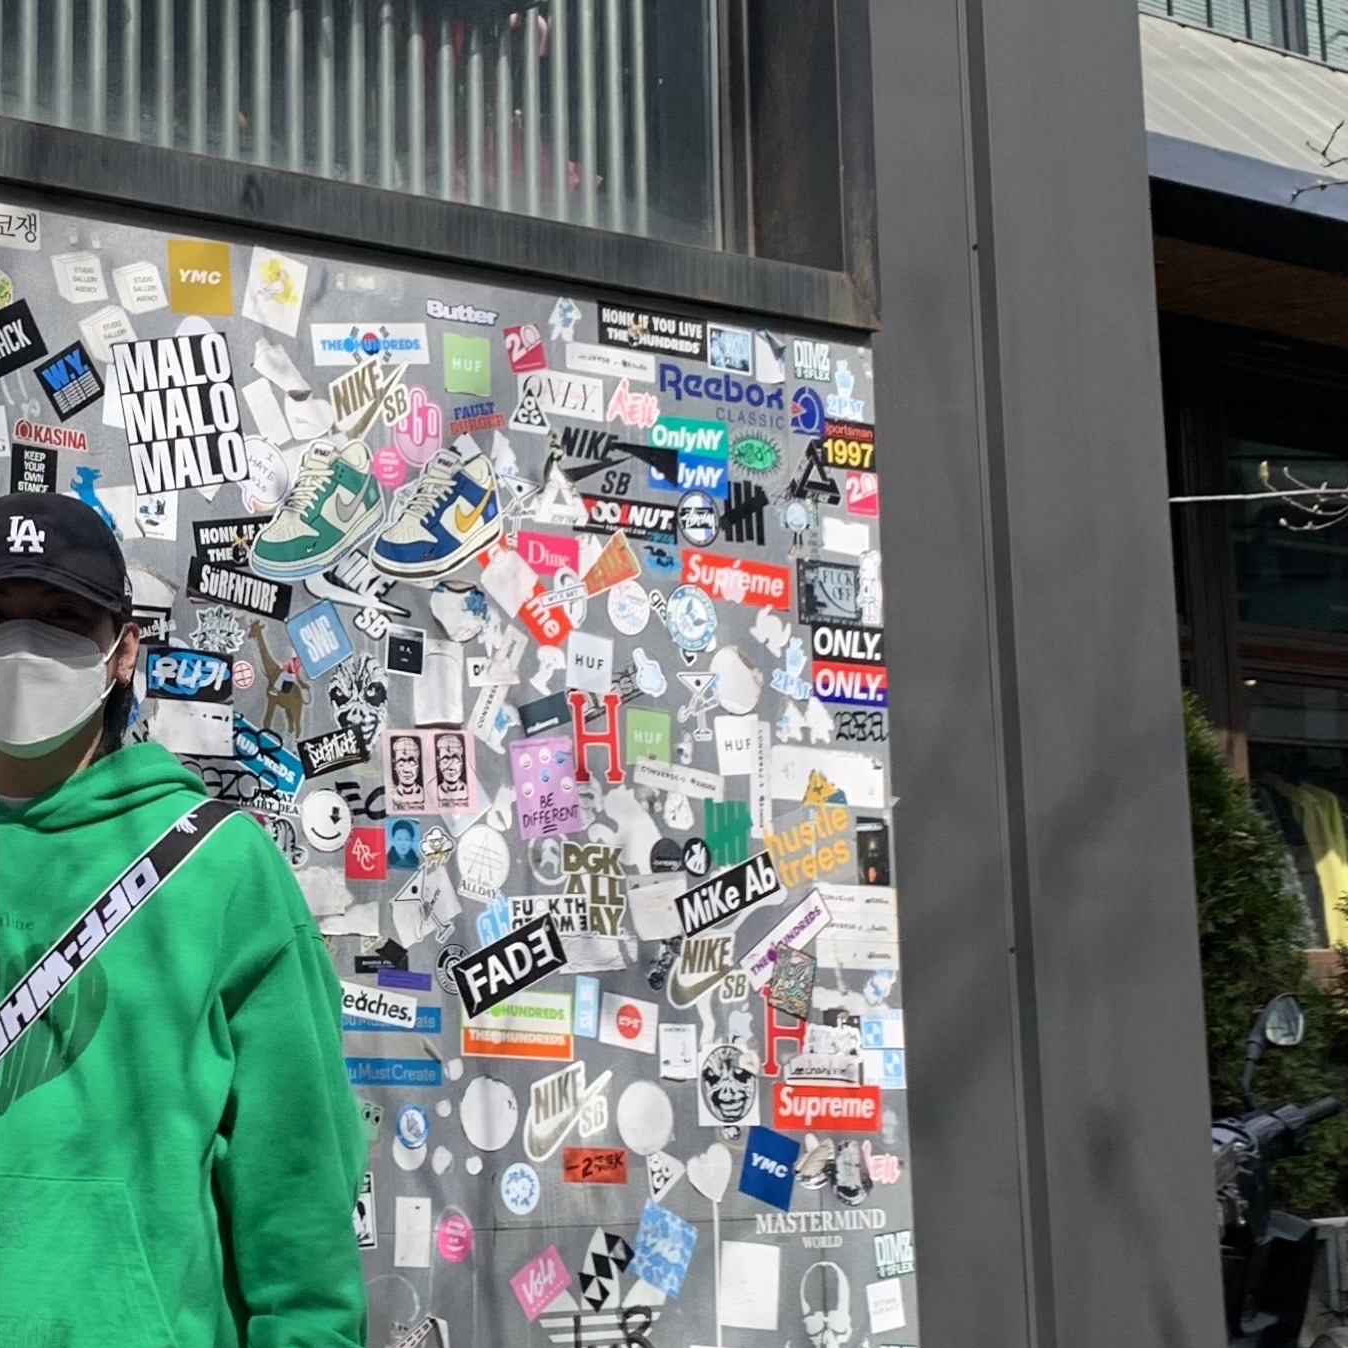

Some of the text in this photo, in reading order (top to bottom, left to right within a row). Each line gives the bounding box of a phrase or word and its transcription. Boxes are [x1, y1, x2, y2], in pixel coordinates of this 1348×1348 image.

[177, 268, 222, 286] YMC
[426, 300, 499, 327] Butter
[602, 307, 634, 327] HONK
[652, 315, 677, 333] YOU
[679, 320, 703, 339] LIVE
[320, 339, 421, 352] THE HUNDREDS
[639, 333, 701, 355] HUNDREDS
[794, 339, 831, 373] DIMZ
[113, 332, 233, 395] MALO
[452, 357, 483, 373] HUF
[333, 361, 385, 423] NIKE
[659, 363, 784, 411] Reebok
[121, 382, 240, 445] MALO
[384, 385, 408, 422] SB
[453, 401, 495, 420] FAULT
[716, 406, 785, 430] CLASSIC
[34, 424, 87, 450] KASINA
[562, 426, 618, 462] NIKE
[652, 425, 724, 452] OnlyNY
[24, 449, 46, 461] KEEP
[24, 461, 46, 473] YOUR
[129, 432, 250, 496] MALO
[823, 438, 875, 468] 1997
[17, 480, 49, 493] STANCE
[23, 471, 44, 484] OWN
[602, 469, 631, 496] SB
[6, 515, 45, 553] LA
[527, 541, 571, 569] Dime
[686, 554, 785, 598] Supreme
[355, 606, 393, 639] SB
[813, 627, 881, 661] ONLY.
[574, 653, 605, 671] HUF
[815, 668, 884, 702] ONLY.
[633, 729, 663, 744] HUF
[724, 738, 751, 751] HUF
[763, 805, 849, 855] hustle
[563, 843, 623, 876] DGK
[779, 837, 851, 888] trees
[459, 878, 498, 899] ALLDAY
[566, 874, 624, 907] ALL
[744, 857, 777, 898] Ab
[465, 925, 556, 1004] FADE
[680, 937, 731, 975] NIKE
[722, 974, 746, 999] SB
[342, 989, 413, 1022] eaches.
[504, 1001, 566, 1019] HUNDREDS
[534, 1065, 583, 1125] NIKE
[779, 1087, 875, 1127] Supreme
[751, 1152, 789, 1179] YMC
[755, 1208, 887, 1234] MASTERMIND
[802, 1235, 843, 1248] WORLD
